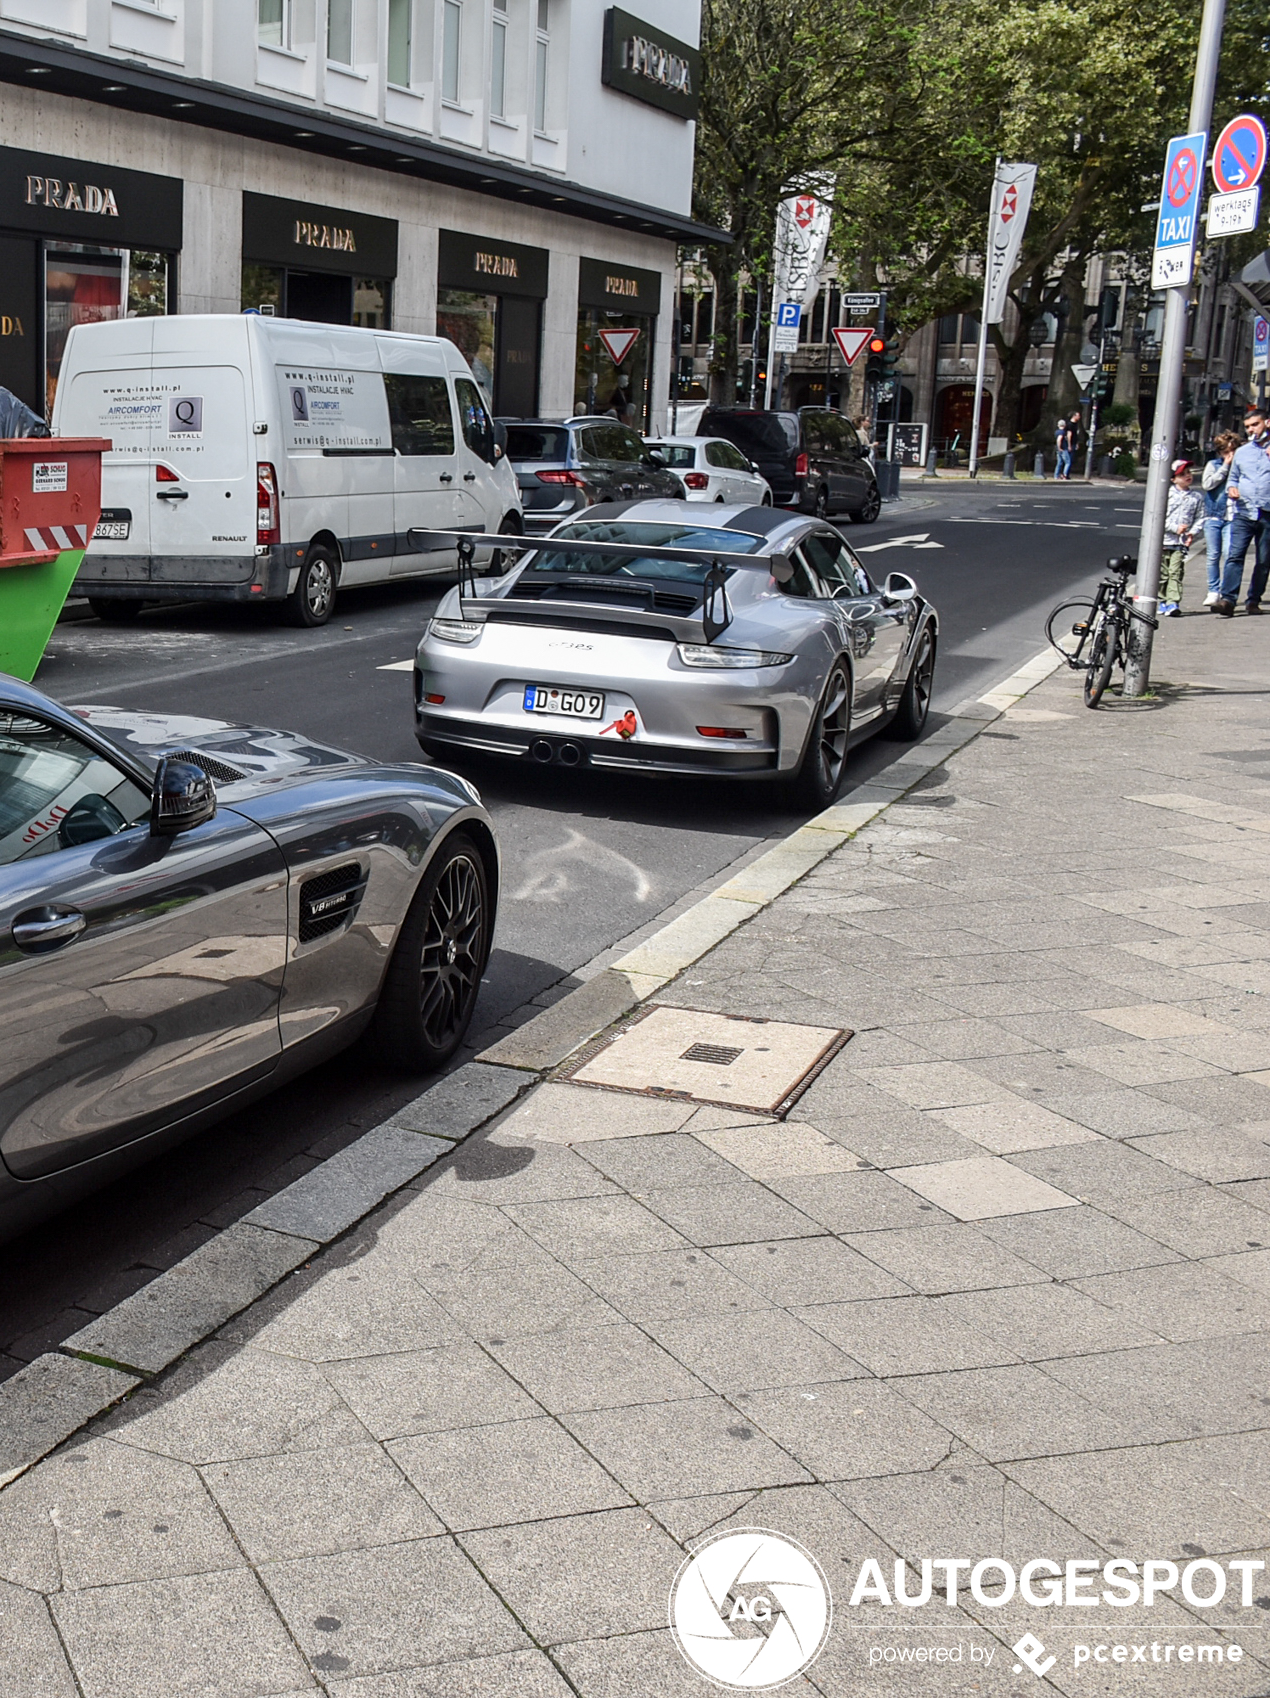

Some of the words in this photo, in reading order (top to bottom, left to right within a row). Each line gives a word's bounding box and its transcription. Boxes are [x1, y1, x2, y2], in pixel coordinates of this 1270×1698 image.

[632, 35, 692, 95] PRADA
[25, 175, 119, 217] PRADA
[1214, 199, 1252, 213] werktags
[294, 220, 356, 252] PRADA
[1161, 216, 1190, 241] TAXI
[474, 252, 519, 278] PRADA
[605, 276, 639, 297] PRADA
[285, 372, 355, 384] www.q-install.pl
[103, 385, 181, 394] www.q-install.pl
[307, 386, 340, 394] INSTALACJE
[340, 387, 354, 395] HVAC
[108, 405, 162, 415] AIRCOMFORT
[293, 390, 304, 414] Q
[311, 401, 340, 410] AIRCOMFORT
[176, 401, 194, 425] Q
[294, 436, 382, 447] serwis@q-install.com.pl
[312, 902, 325, 915] V8
